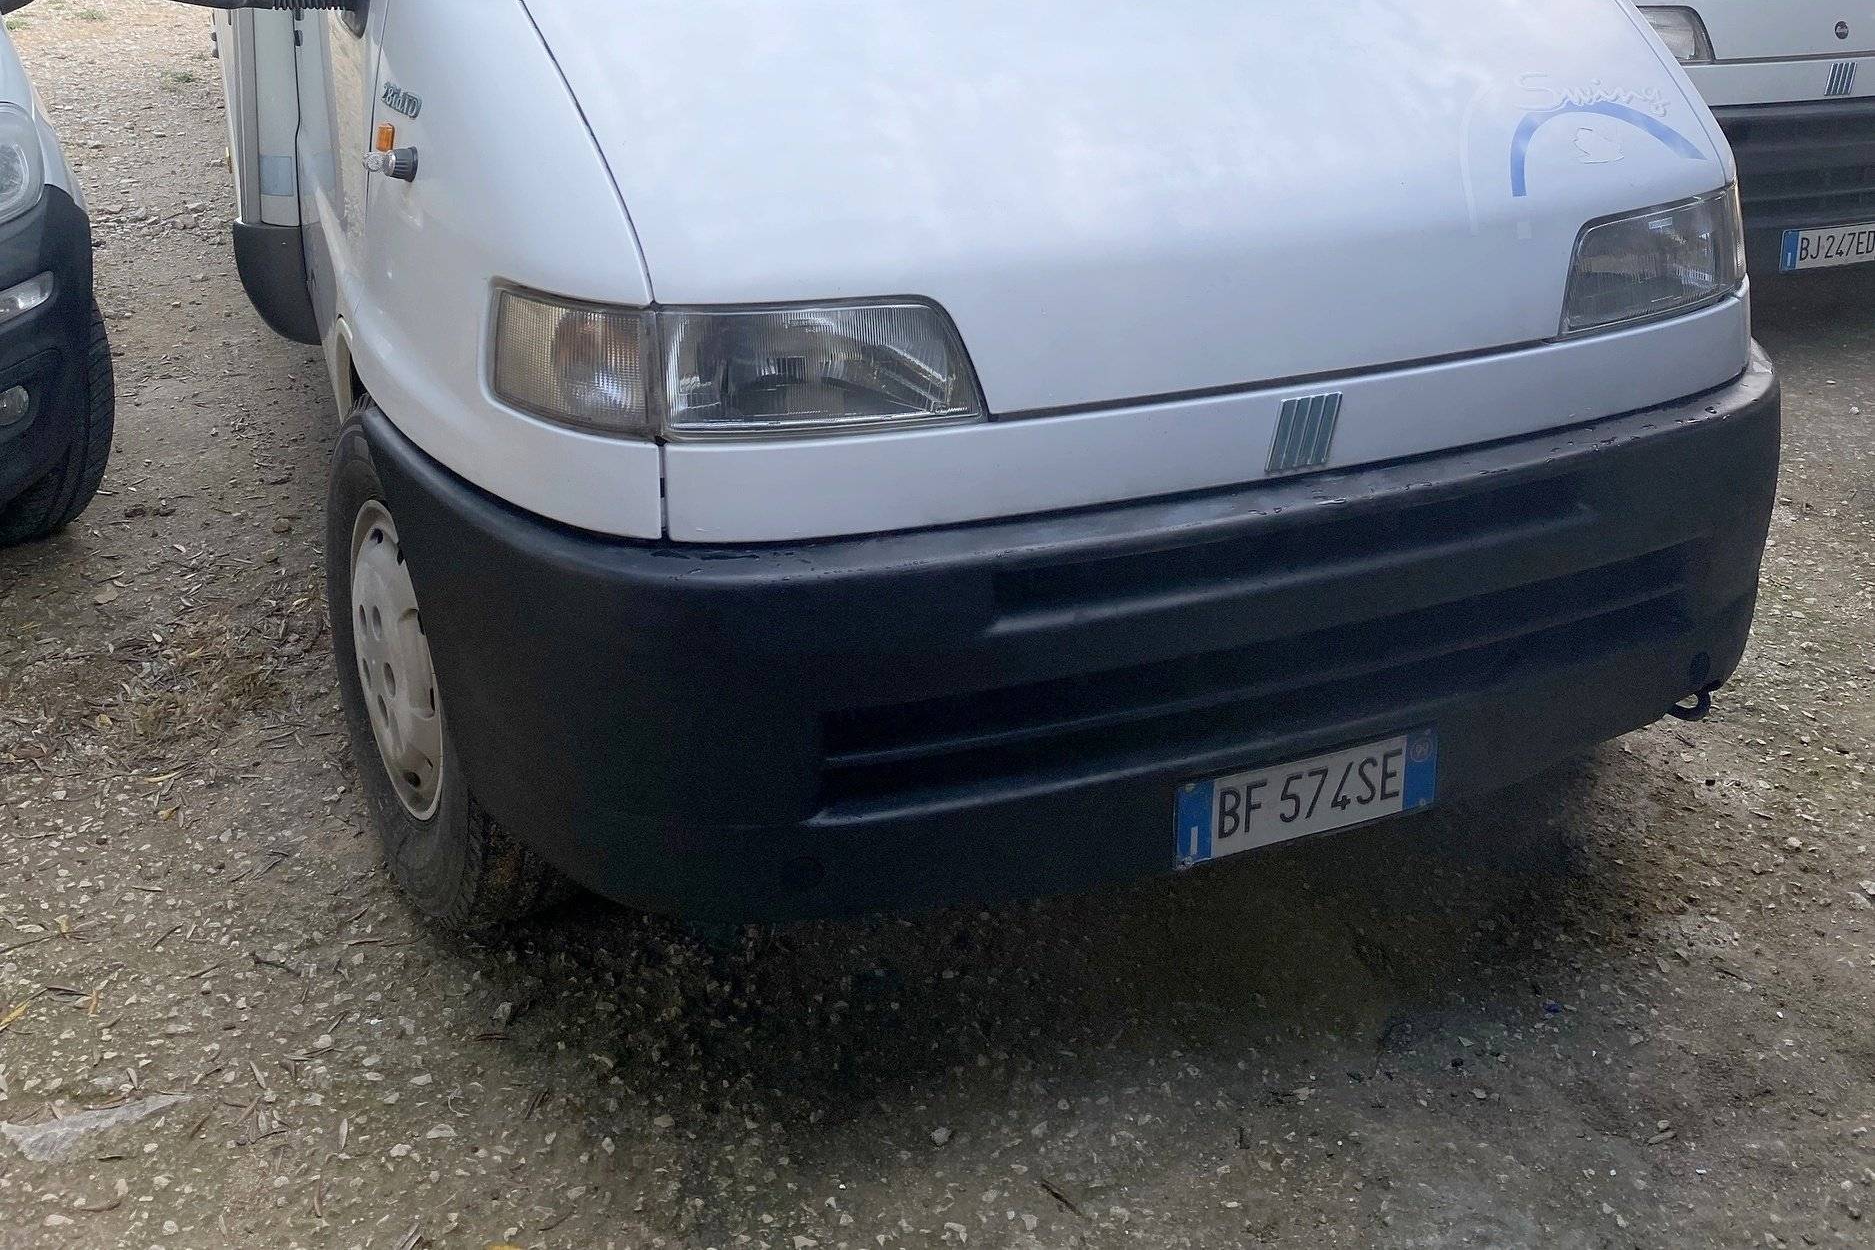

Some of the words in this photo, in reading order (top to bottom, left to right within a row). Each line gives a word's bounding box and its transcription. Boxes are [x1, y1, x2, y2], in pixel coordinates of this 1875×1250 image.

[1799, 235, 1821, 261] BJ
[1824, 230, 1875, 259] 247ED
[1217, 778, 1268, 840] BF
[1279, 748, 1403, 823] 574SE
